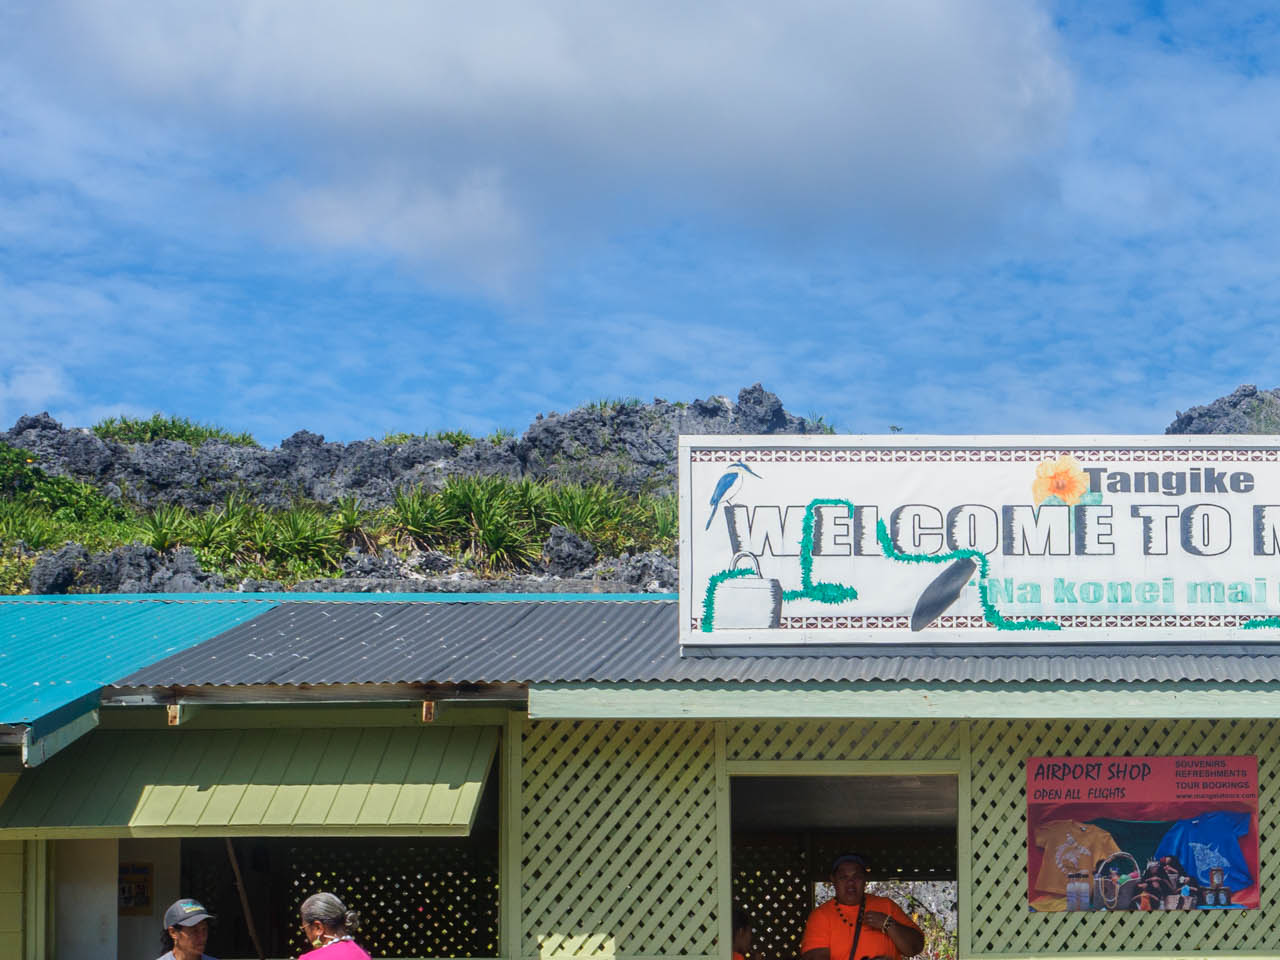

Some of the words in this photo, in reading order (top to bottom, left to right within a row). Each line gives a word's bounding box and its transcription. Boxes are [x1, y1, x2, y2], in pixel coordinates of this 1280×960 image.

[1086, 467, 1255, 496] Tangike
[724, 503, 1115, 557] WELCOME
[1131, 503, 1233, 557] TO
[1053, 577, 1175, 604] konei
[1186, 577, 1268, 604] mai
[1034, 762, 1102, 781] AIRPORT
[1107, 762, 1151, 780] SHOP
[1175, 760, 1227, 768] SOUVENIRS
[1175, 769, 1248, 778] REFRESHMENTS
[1033, 789, 1062, 800] OPEN
[1064, 788, 1081, 800] ALL
[1087, 787, 1126, 800] FLIGHTS
[1175, 782, 1200, 790] TOUR
[1202, 781, 1250, 789] BOOKINGS
